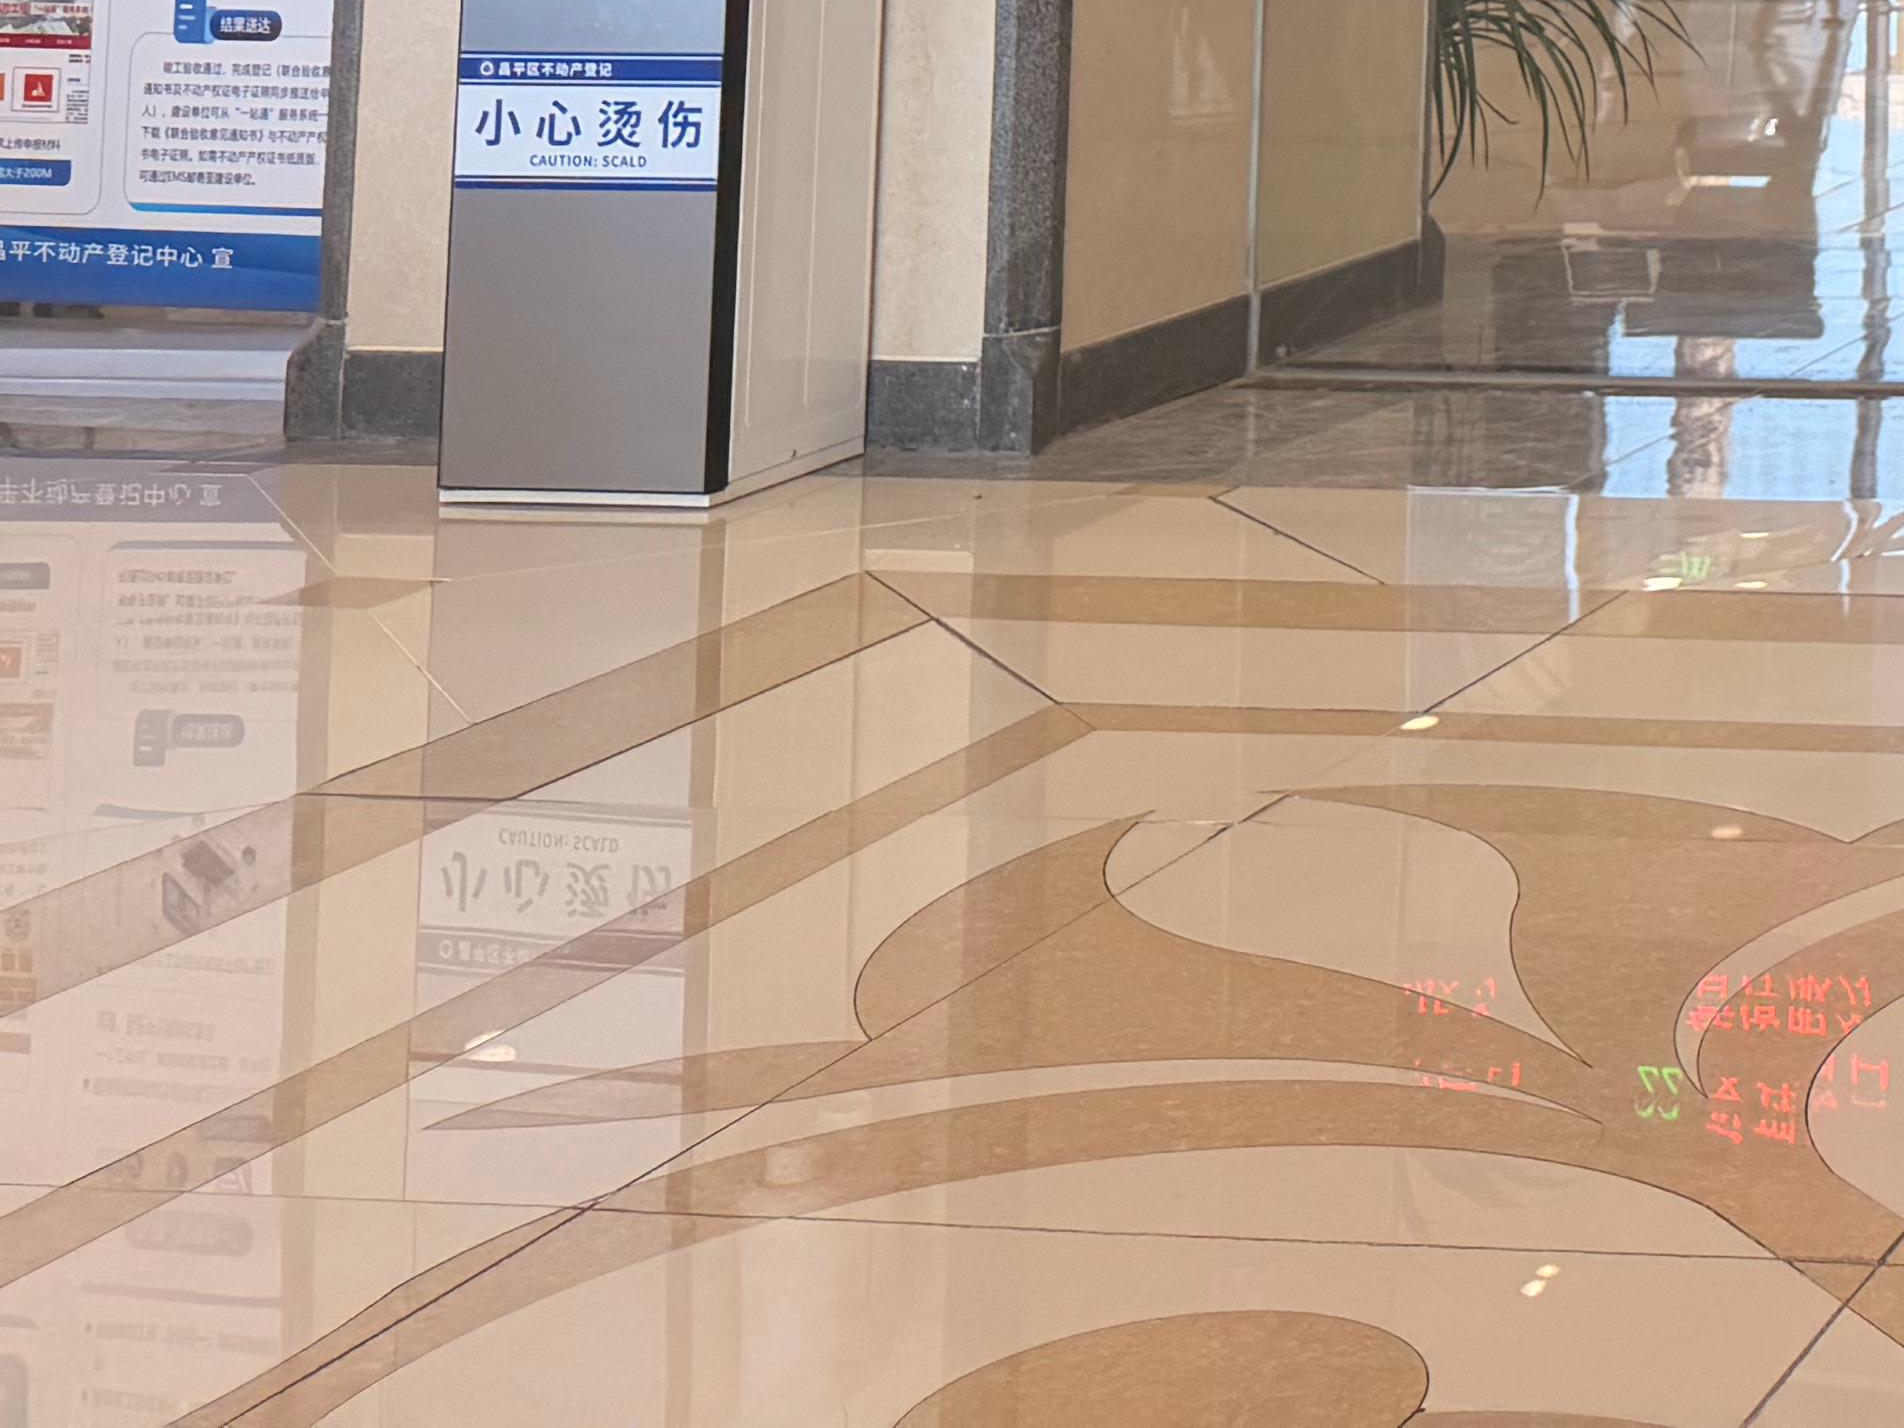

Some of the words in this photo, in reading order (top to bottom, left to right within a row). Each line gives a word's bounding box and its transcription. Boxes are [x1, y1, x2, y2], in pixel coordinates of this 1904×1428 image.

[498, 60, 613, 78] 昌平区不动产登记
[474, 98, 704, 150] 小心烫伤
[529, 153, 599, 169] CAUTION:
[602, 154, 648, 170] SCALD
[211, 247, 235, 270] 宣
